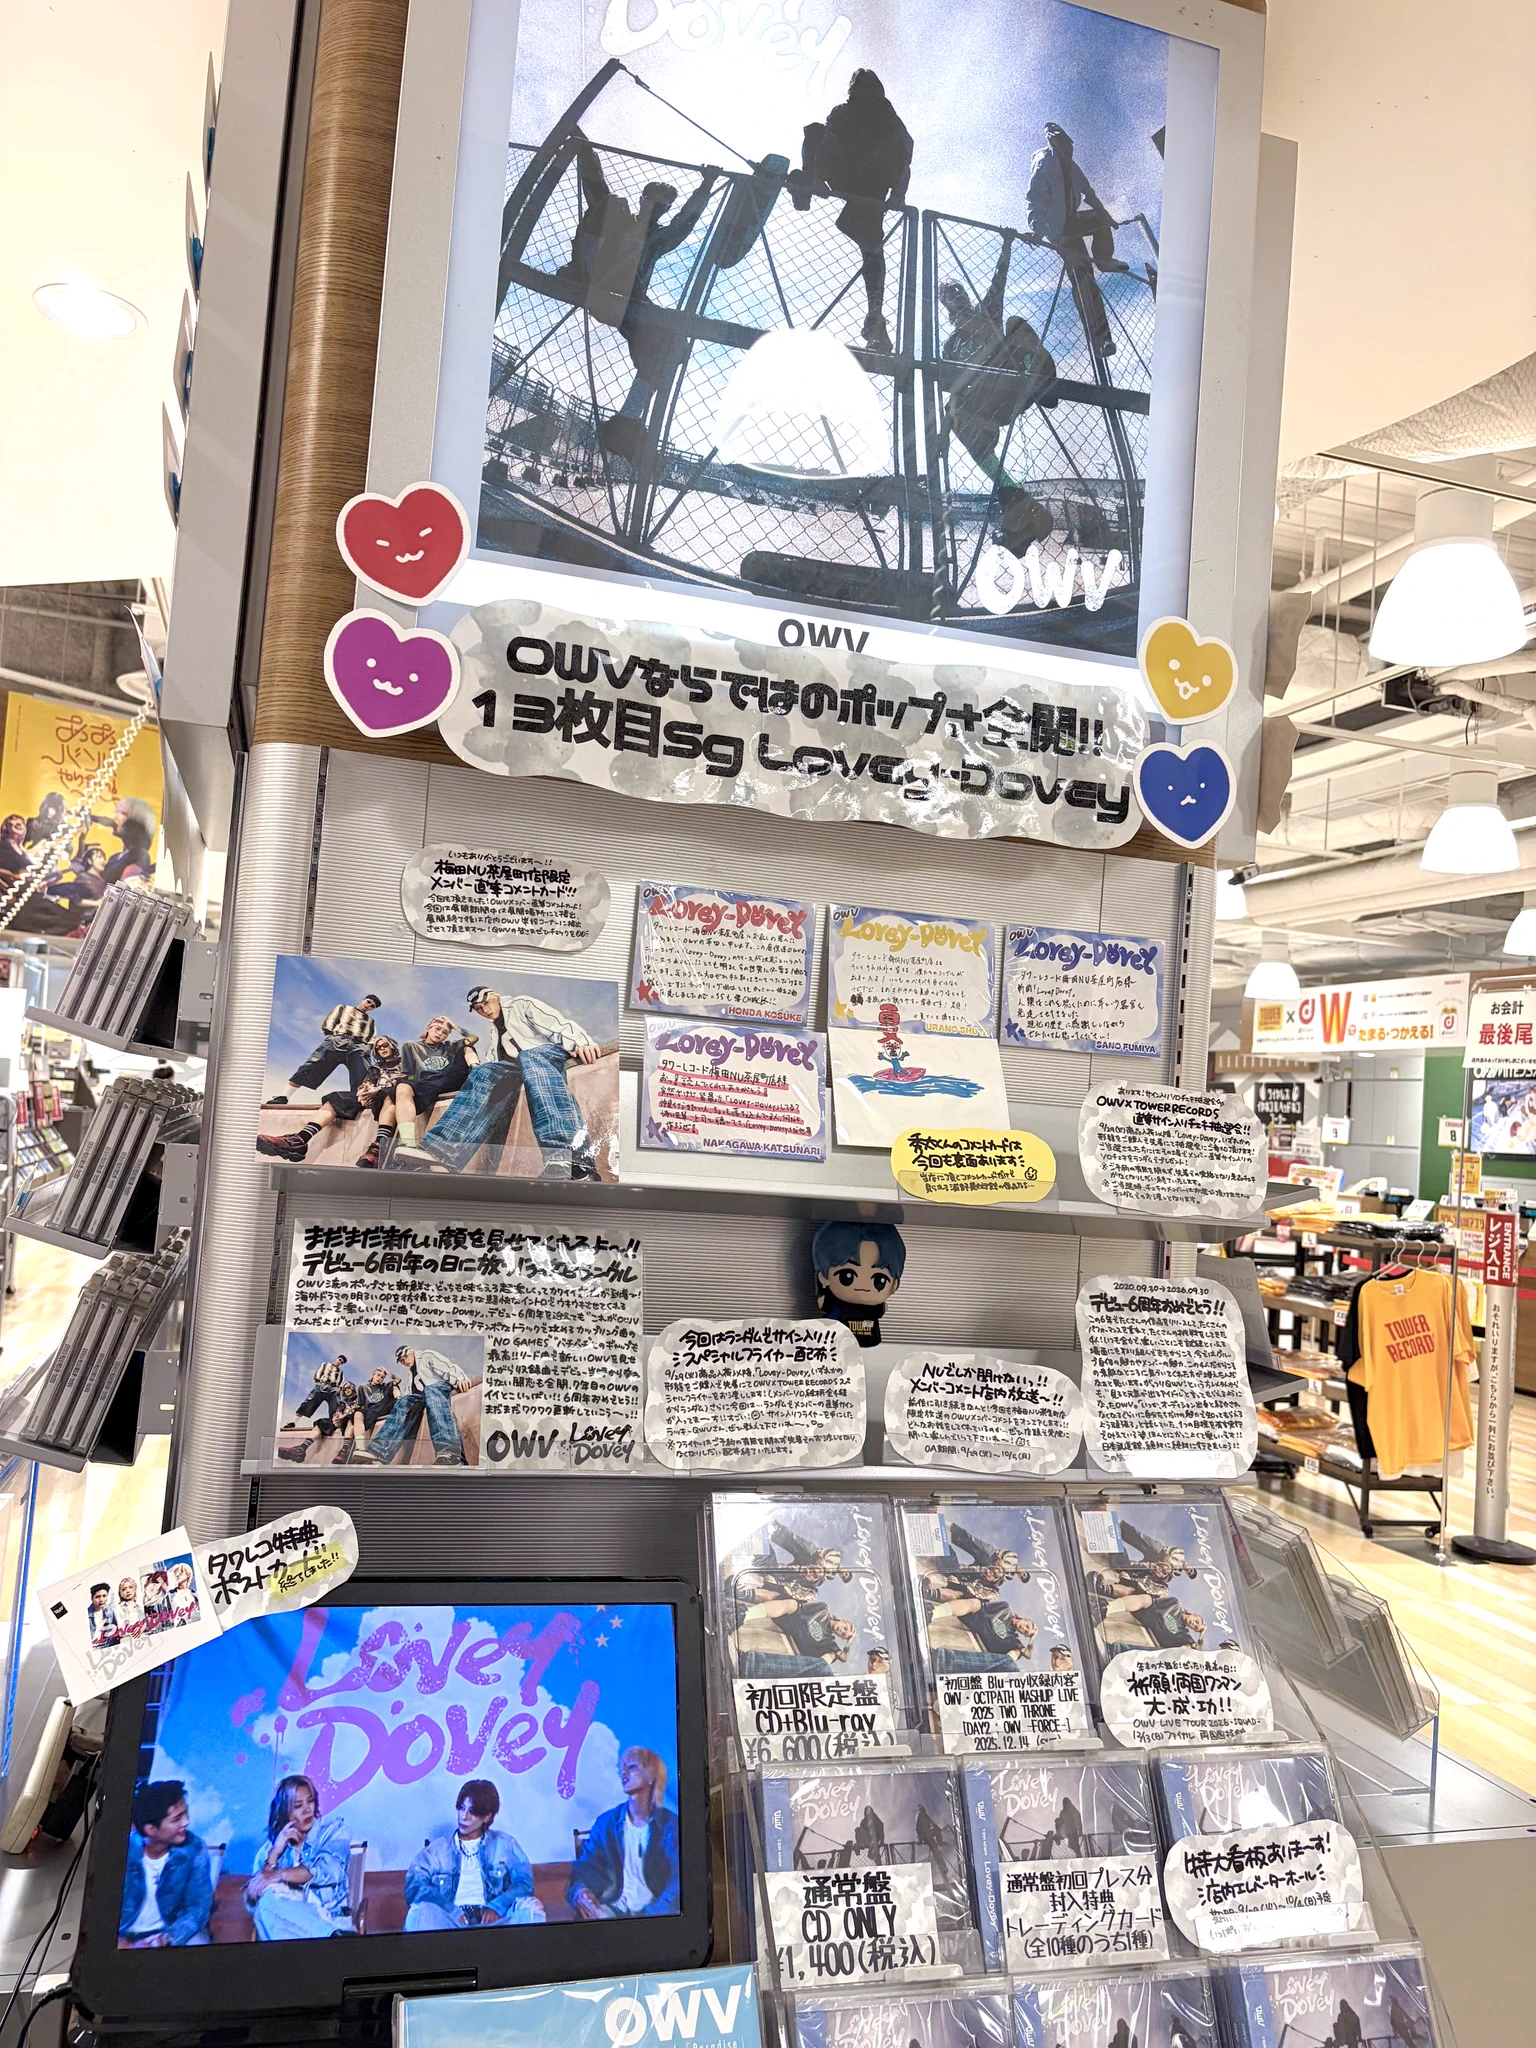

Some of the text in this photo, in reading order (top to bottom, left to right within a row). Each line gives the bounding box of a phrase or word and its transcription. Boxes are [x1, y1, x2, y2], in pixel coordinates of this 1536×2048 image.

[976, 544, 1123, 615] OWV
[779, 619, 870, 653] OWV
[434, 859, 571, 885] 梅田NU茶屋町店限定
[649, 895, 808, 940] Lovey-Dovey
[833, 907, 860, 922] OWV
[840, 915, 987, 958] Lovey-Dovey
[1009, 928, 1035, 941] OWV
[1014, 937, 1158, 976] Lovey-Dovey
[728, 1006, 803, 1022] HONDA KOSUKE
[1490, 1000, 1524, 1016] お会計
[649, 1019, 677, 1034] OWV
[926, 1023, 958, 1034] URANO
[1478, 1022, 1534, 1046] 最後尾
[655, 1033, 818, 1071] Lovey-Dovey
[1096, 1041, 1156, 1054] SANO FUMIYA
[703, 1138, 821, 1156] NAKAGAWA KATSUNARI
[907, 1132, 1023, 1153] 秀太くんのコメントカードは
[1487, 1217, 1502, 1281] レジ入口
[1502, 1221, 1513, 1281] ENTRANCE
[1384, 1313, 1431, 1341] TOWER
[486, 1429, 560, 1462] OWV
[571, 1440, 636, 1466] Dovey
[207, 1519, 325, 1576] タワレコ特典
[210, 1543, 327, 1604] ポストカード
[279, 1606, 587, 1712] Lovey
[745, 1680, 881, 1711] 初回限定盤
[944, 1688, 1080, 1706] OWV OCTPATH MASHUP LIVE
[1127, 1671, 1242, 1697] 祈願!両国ワンマン
[756, 1710, 876, 1734] CD+Blu-ray
[970, 1704, 1057, 1720] 2025 TWO THRONE
[1003, 1720, 1021, 1733] OWV
[1133, 1718, 1155, 1728] OWV
[1160, 1718, 1182, 1728] LIVE
[1186, 1718, 1208, 1728] TOUR
[297, 1680, 600, 1818] Dovey
[802, 1871, 893, 1910] 通常盤
[1006, 1865, 1153, 1894] 通常盤初回プレス分
[1049, 1891, 1116, 1913] 封入特典
[802, 1904, 898, 1944] CD ONLY
[1006, 1906, 1163, 1940] トレーディングカード
[1274, 1971, 1330, 2000] Lovey
[604, 1984, 743, 2047] OWV
[1280, 1987, 1335, 2024] Dovey
